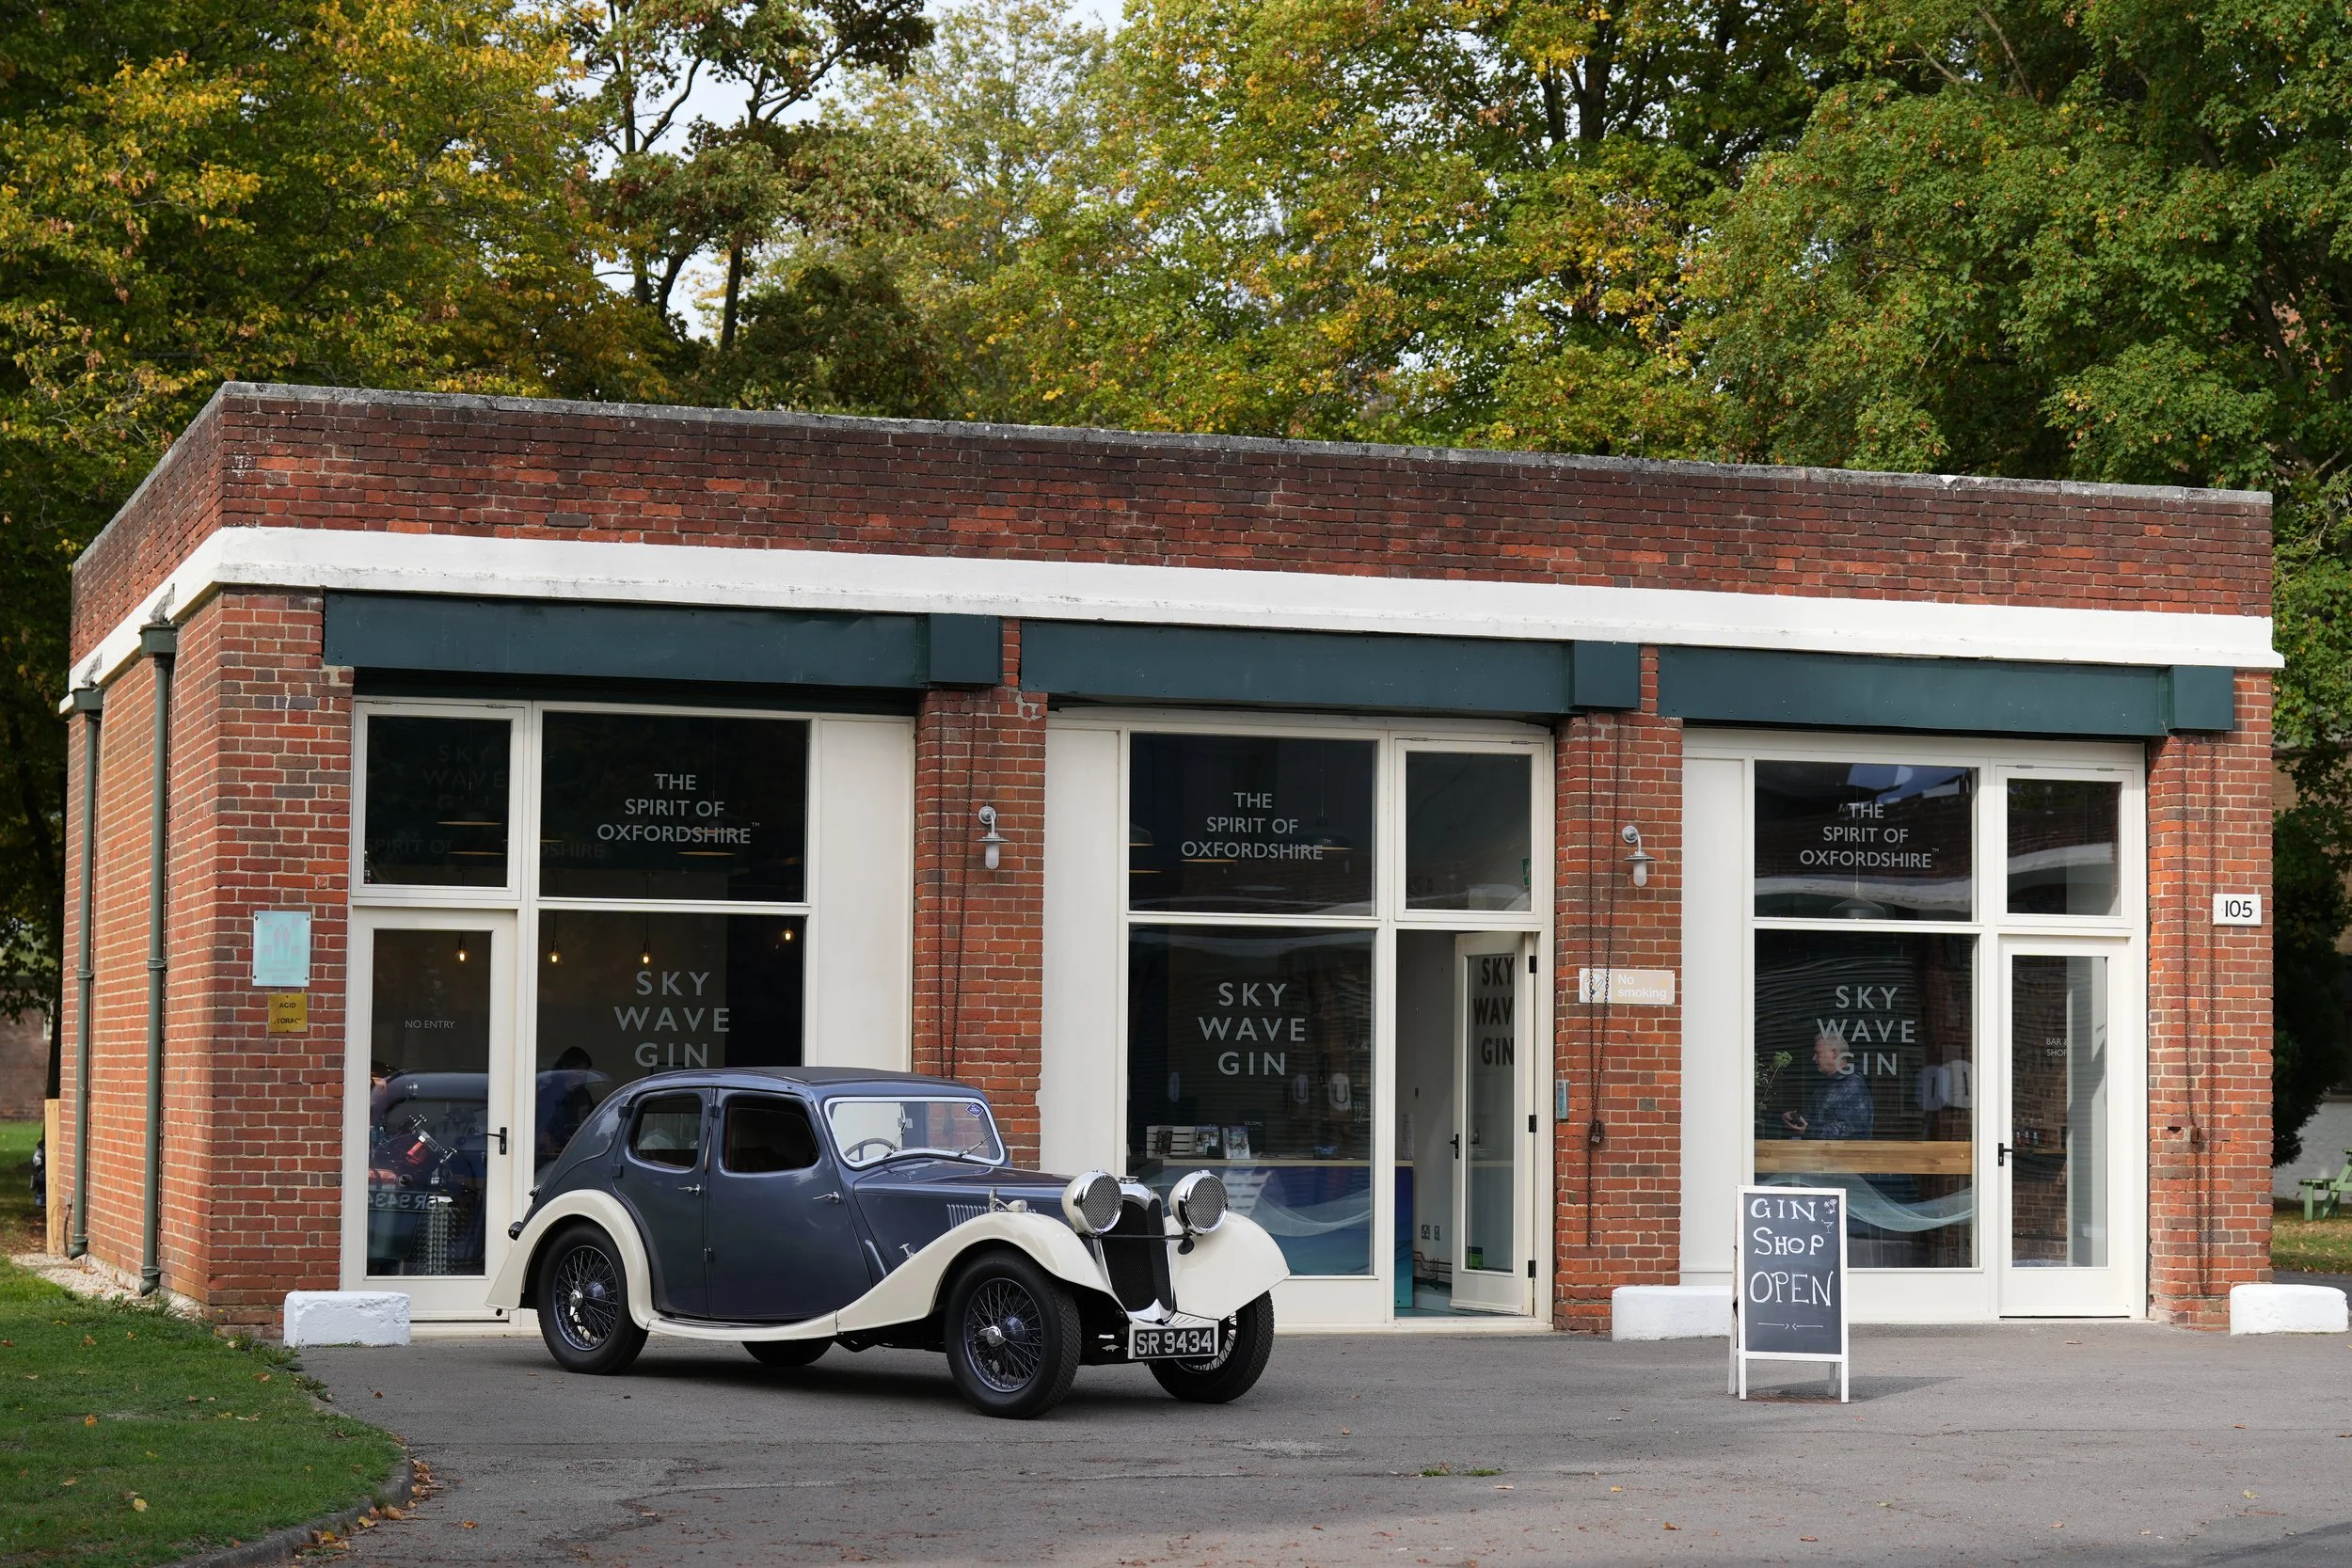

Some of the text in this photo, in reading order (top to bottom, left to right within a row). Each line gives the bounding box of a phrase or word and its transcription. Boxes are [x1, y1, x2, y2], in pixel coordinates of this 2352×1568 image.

[654, 773, 696, 790] THE
[625, 799, 724, 816] SPIRIT OF
[1232, 792, 1272, 808] THE
[1847, 802, 1884, 818] THE
[596, 823, 751, 844] OXFORDSHIRE
[1206, 816, 1298, 834] SPIRIT OF
[1822, 826, 1909, 844] SPIRIT OF
[1181, 840, 1323, 861] OXFORDSHIRE
[1800, 849, 1931, 868] OXFORDSHIRE
[2225, 900, 2253, 918] 105
[636, 971, 710, 996] SKY
[1482, 958, 1515, 986] SKY
[1617, 974, 1634, 985] No
[1218, 982, 1287, 1006] SKY
[1617, 988, 1667, 1000] smoking
[1836, 985, 1899, 1009] SKY
[613, 1006, 729, 1032] WAVE
[1473, 997, 1514, 1025] WAV
[405, 1020, 456, 1030] NO ENTRY
[1198, 1017, 1306, 1041] WAVE
[1817, 1019, 1915, 1043] WAVE
[1481, 1037, 1514, 1067] GIN
[2045, 1037, 2061, 1046] BAR
[635, 1042, 707, 1068] GIN
[1217, 1051, 1285, 1075] GIN
[1836, 1052, 1897, 1075] GIN
[1750, 1197, 1817, 1222] GIN
[1753, 1227, 1824, 1256] SHOP
[1749, 1271, 1835, 1307] OPEN
[1136, 1330, 1213, 1354] SR 9434
